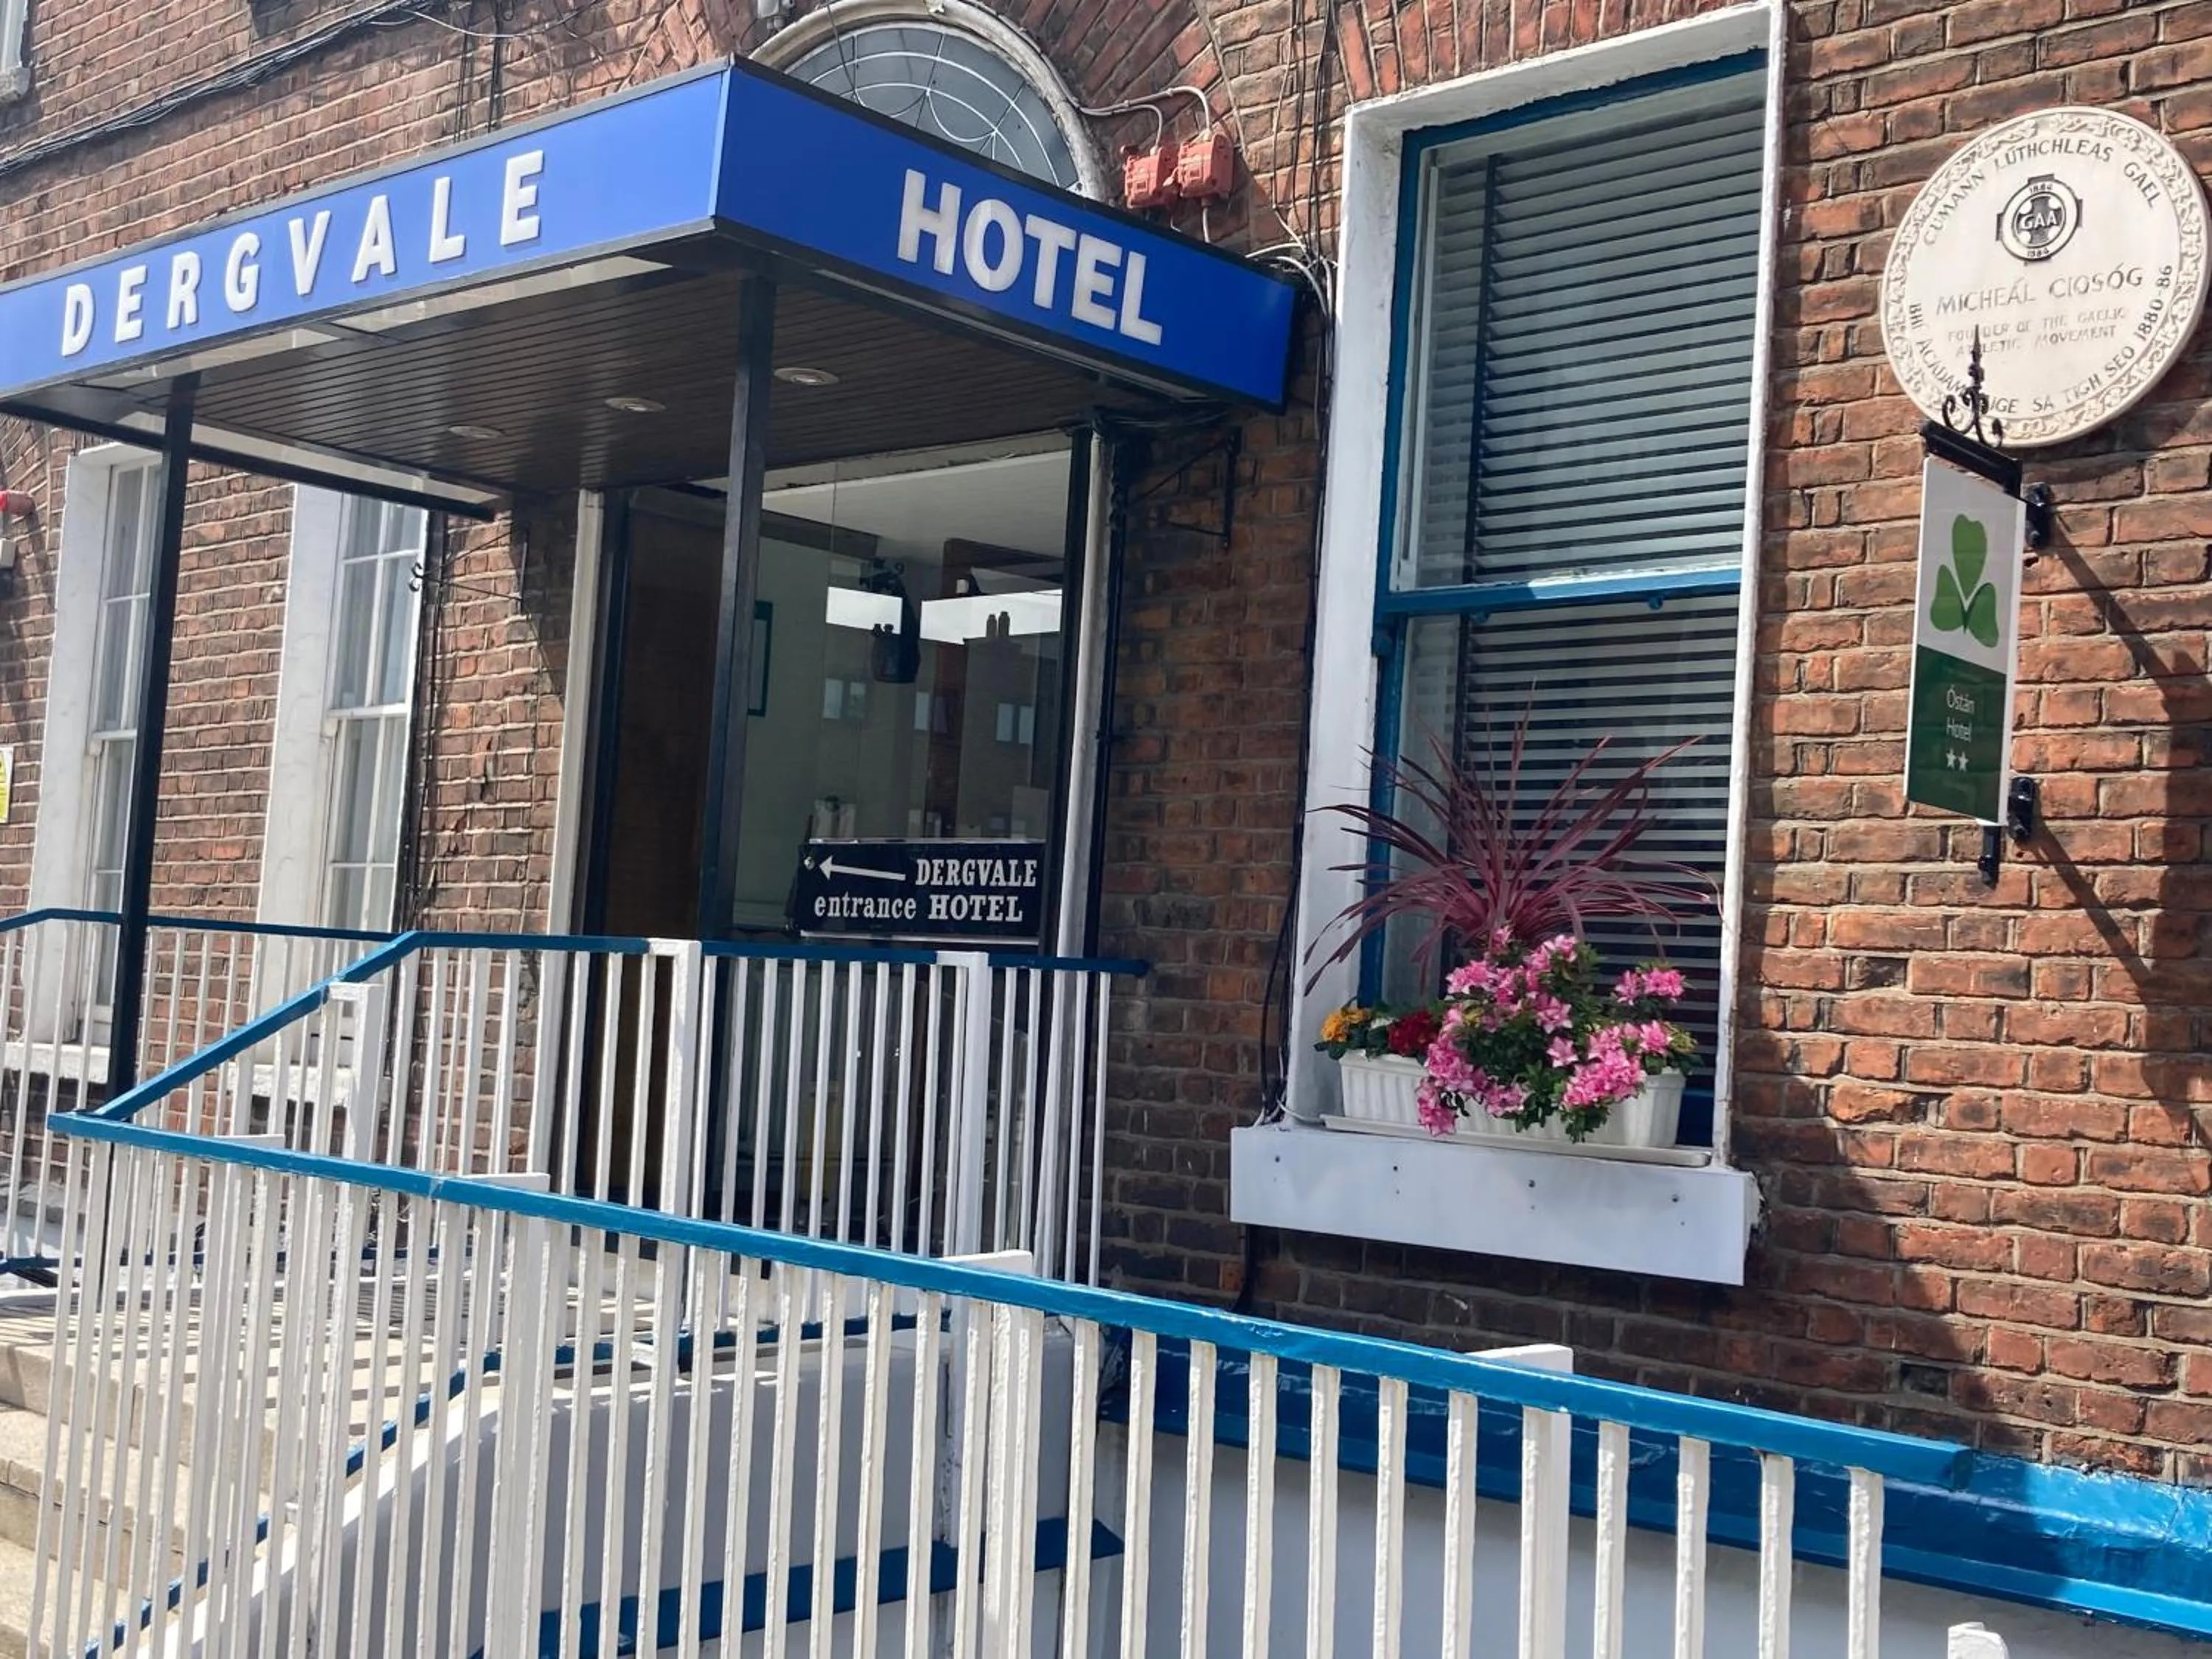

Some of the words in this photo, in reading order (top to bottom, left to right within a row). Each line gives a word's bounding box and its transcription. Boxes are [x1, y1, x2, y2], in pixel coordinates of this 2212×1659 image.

[1924, 168, 1985, 246] CUMANN
[2123, 161, 2161, 209] GAEL
[2020, 210, 2058, 230] GAA
[62, 150, 544, 357] DERGVALE
[897, 168, 1163, 346] HOTEL
[1935, 276, 2037, 316] MICHEÁL
[2077, 307, 2126, 323] GAELIC
[2033, 394, 2054, 412] SA
[2062, 373, 2102, 403] TIGH
[2105, 346, 2135, 378] SEO
[2134, 265, 2173, 342] 1880-86
[2034, 324, 2117, 349] MOVEMENT
[1947, 717, 1972, 743] Hotel
[915, 858, 1038, 887] DERGVALE
[814, 891, 917, 920] entrance
[928, 894, 1023, 922] HOTEL
